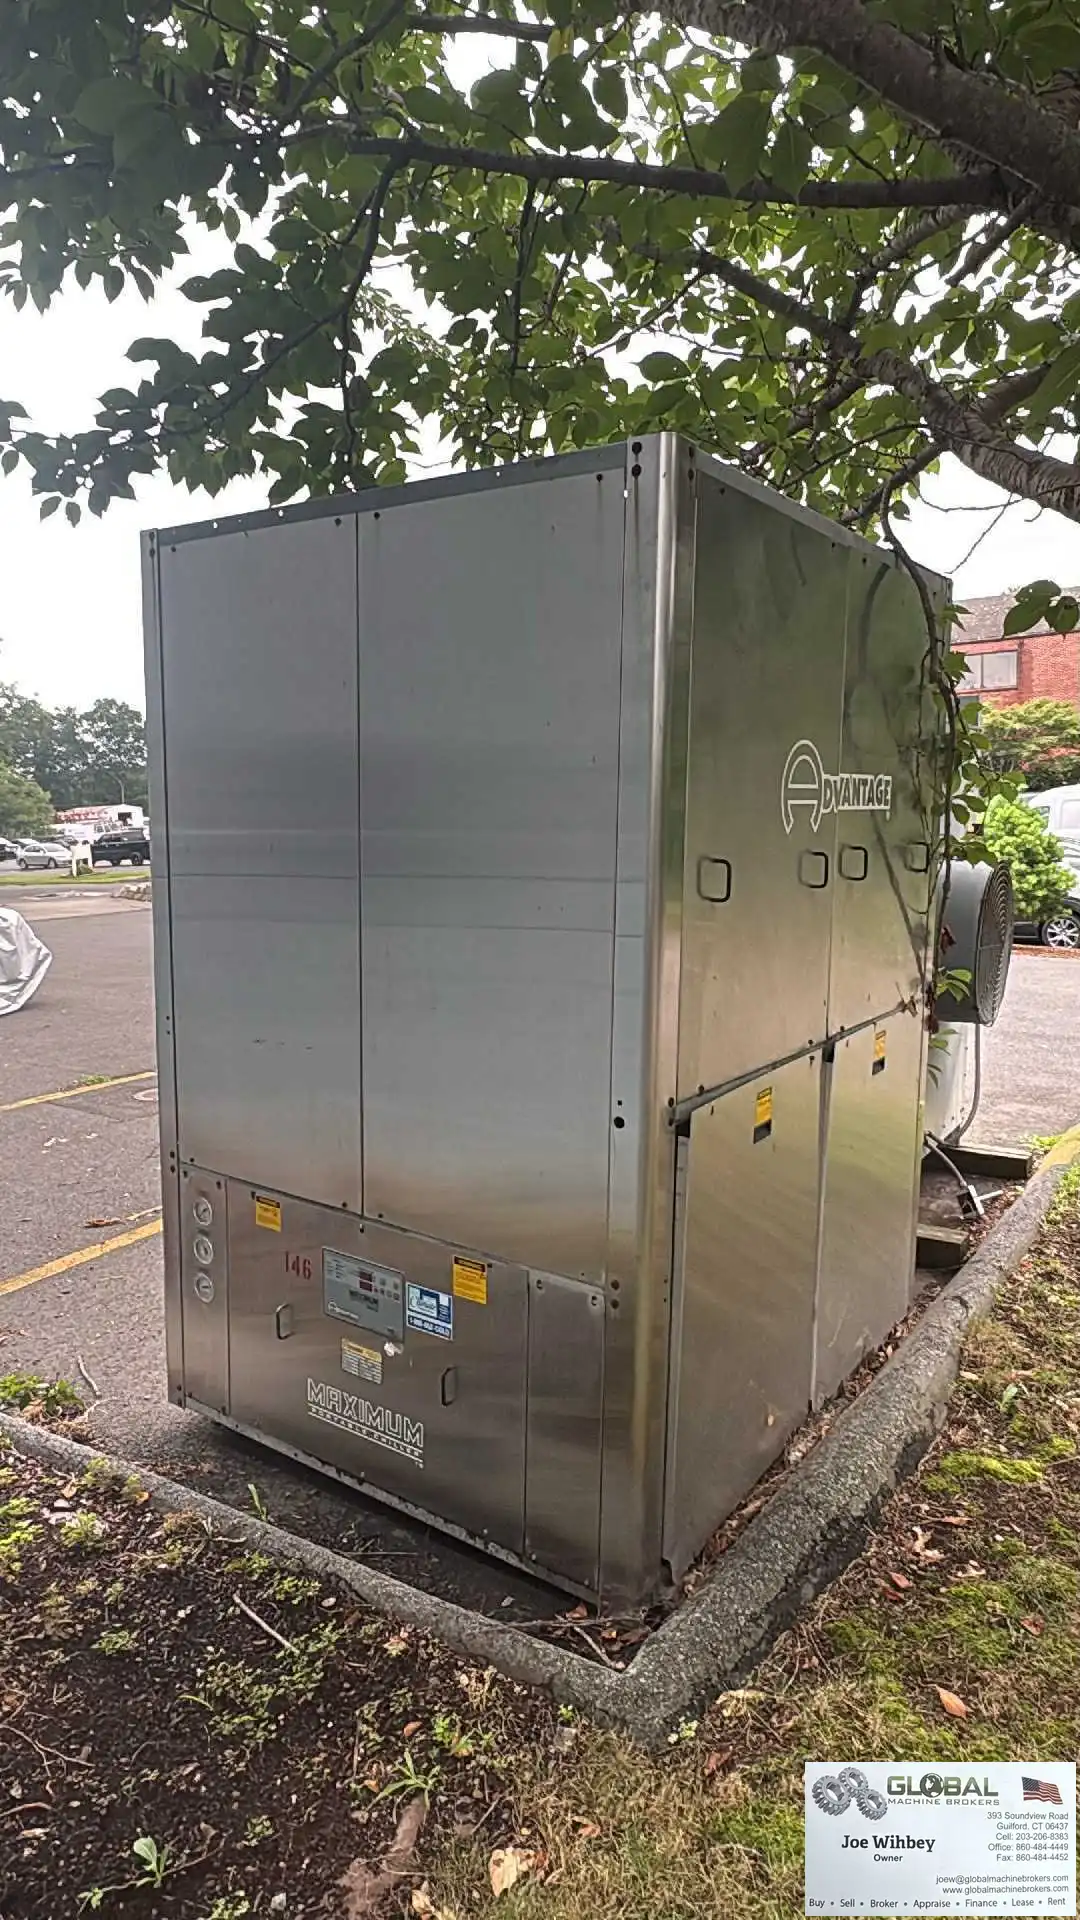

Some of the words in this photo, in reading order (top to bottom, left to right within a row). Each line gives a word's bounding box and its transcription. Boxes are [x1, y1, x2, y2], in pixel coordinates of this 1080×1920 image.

[781, 739, 893, 835] ADVANTAGE
[285, 1251, 312, 1280] 146
[307, 1377, 424, 1448] MAXIMUM
